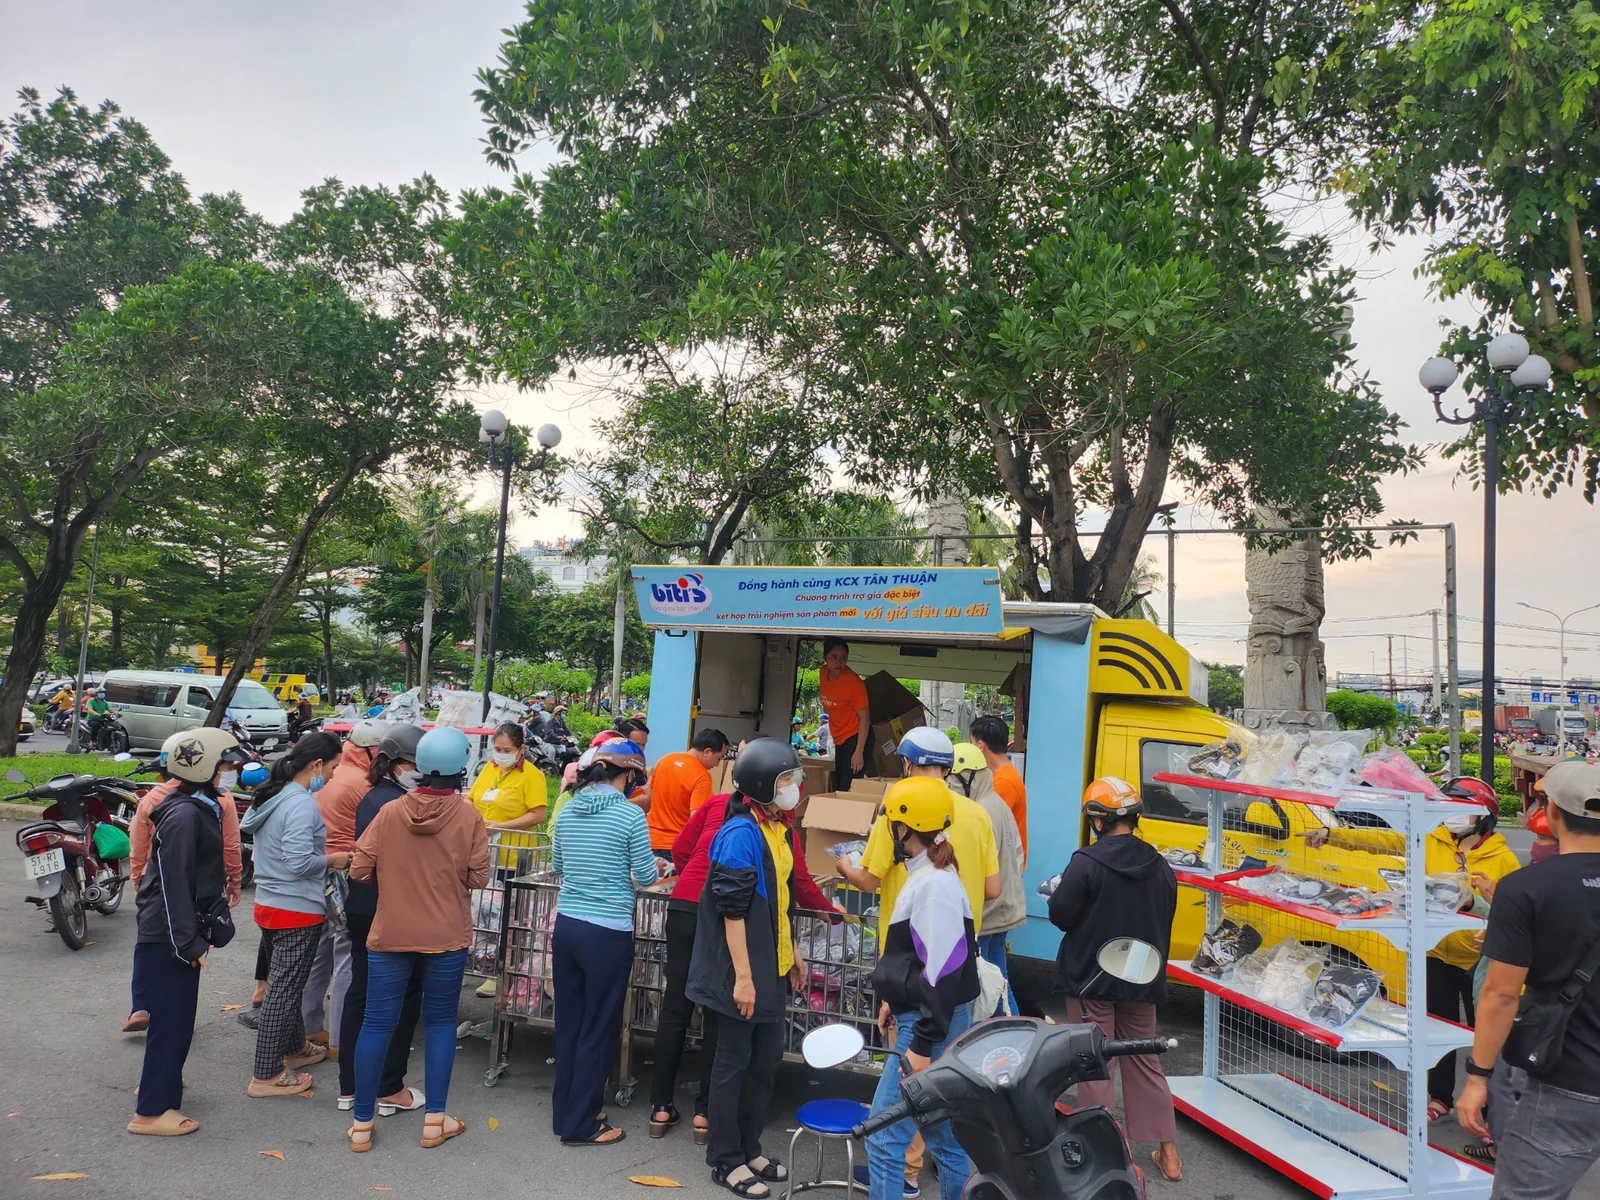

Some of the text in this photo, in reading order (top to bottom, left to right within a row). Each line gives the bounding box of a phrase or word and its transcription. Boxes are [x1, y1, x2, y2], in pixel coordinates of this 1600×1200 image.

[738, 570, 938, 592] Đồng hành cùng KCX TÂN THUẬN
[795, 588, 921, 603] Chương trình trợ giá đặc biệt
[716, 602, 990, 623] kết hợp trải nghiệm sản phẩm mới với giá siêu ưu đãi
[31, 851, 57, 867] 51-R1
